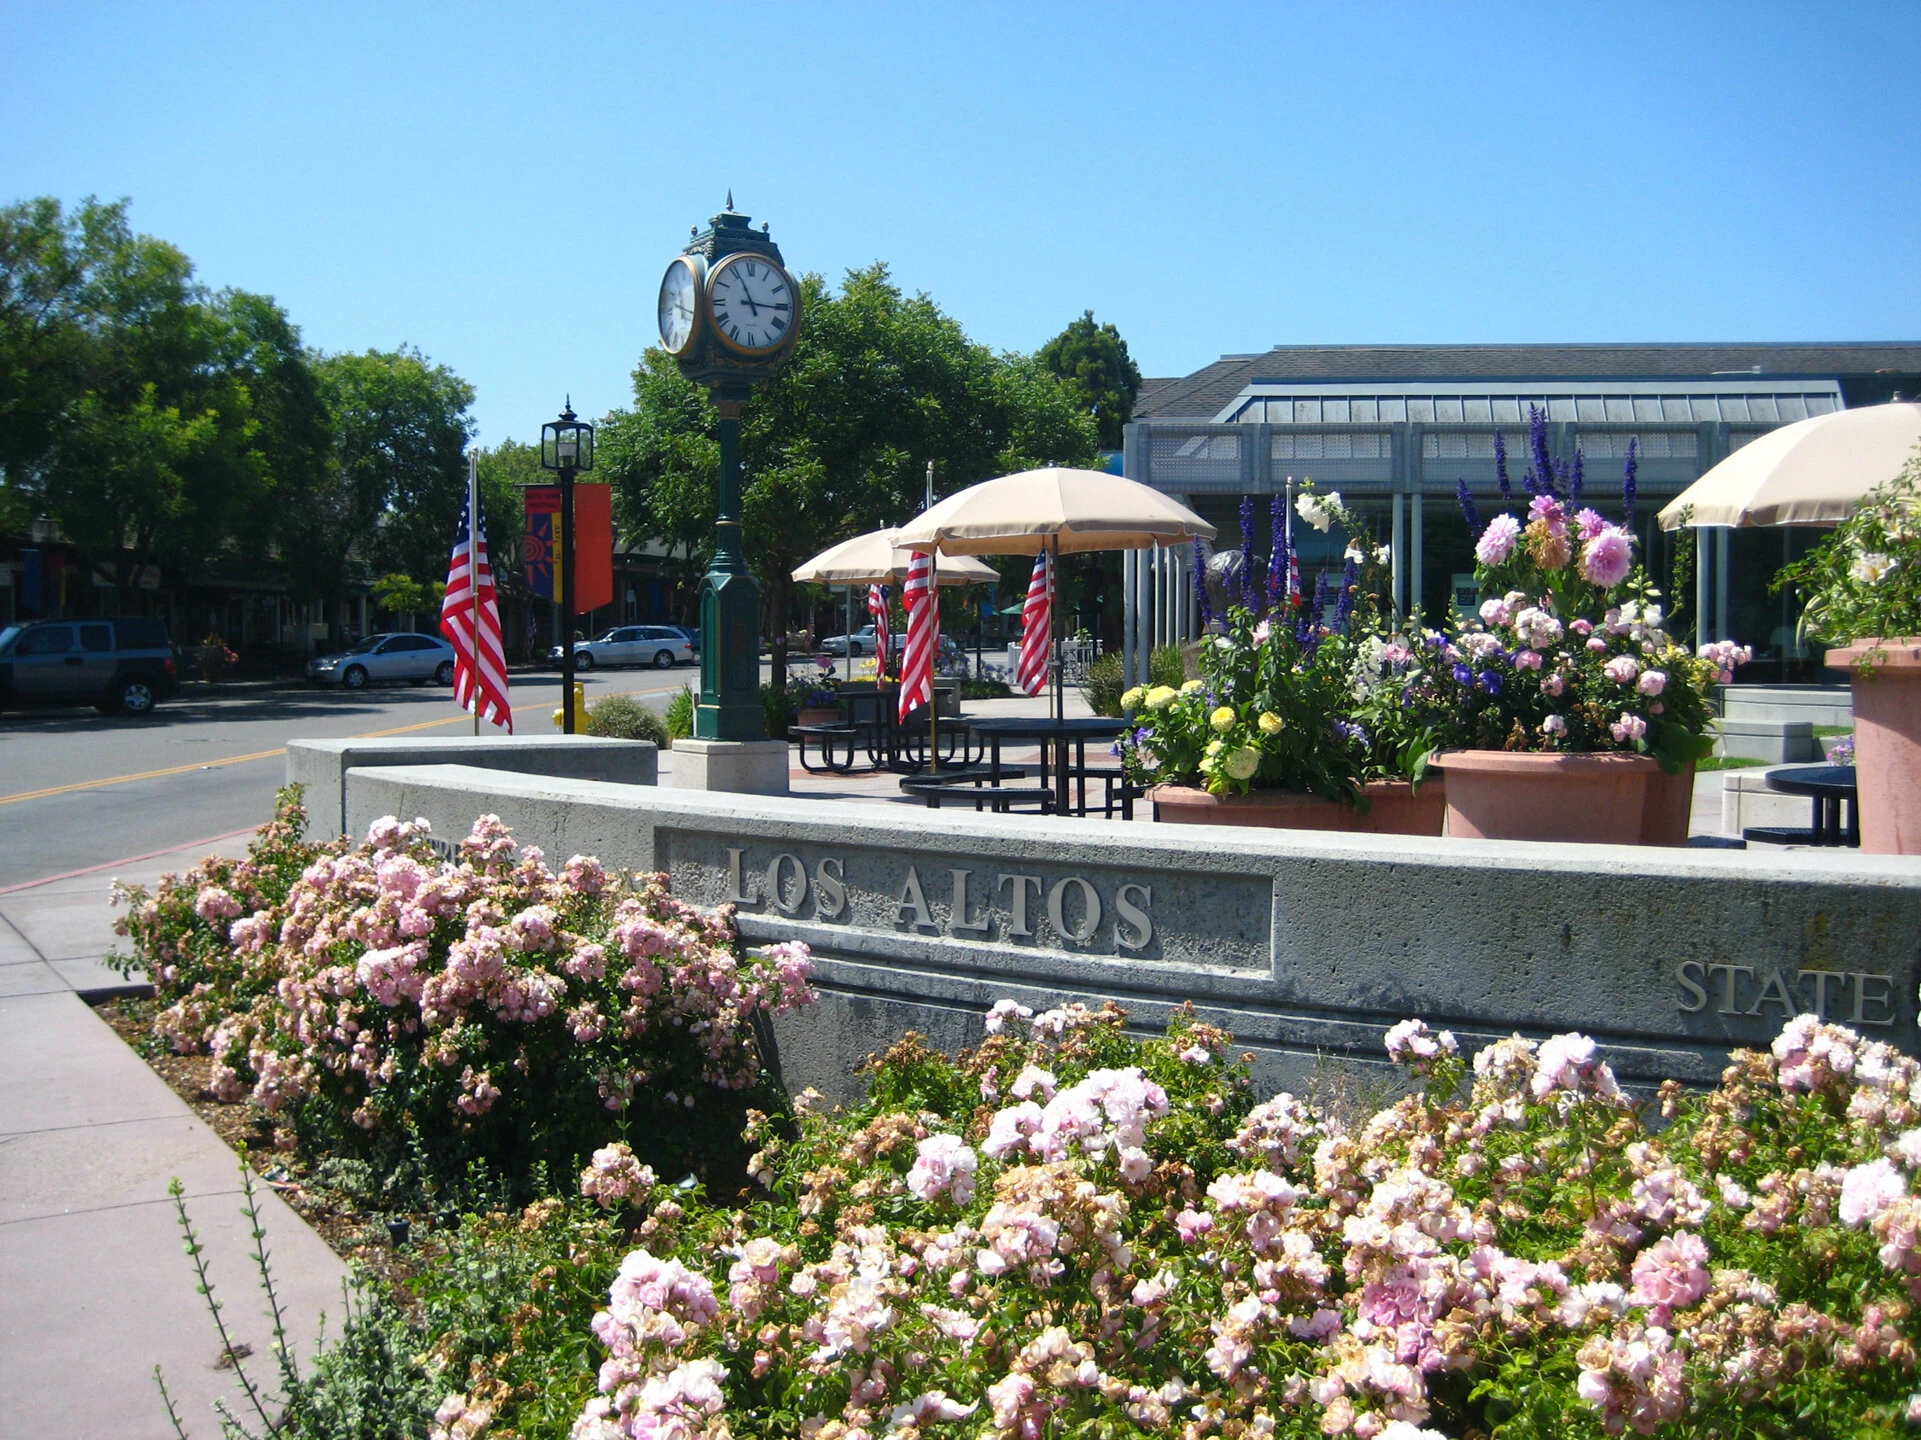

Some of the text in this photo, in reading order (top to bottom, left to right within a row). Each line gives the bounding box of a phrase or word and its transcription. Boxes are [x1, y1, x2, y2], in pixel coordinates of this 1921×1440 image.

[727, 848, 1152, 949] LOS ALTOS
[1674, 960, 1896, 1026] STATE
